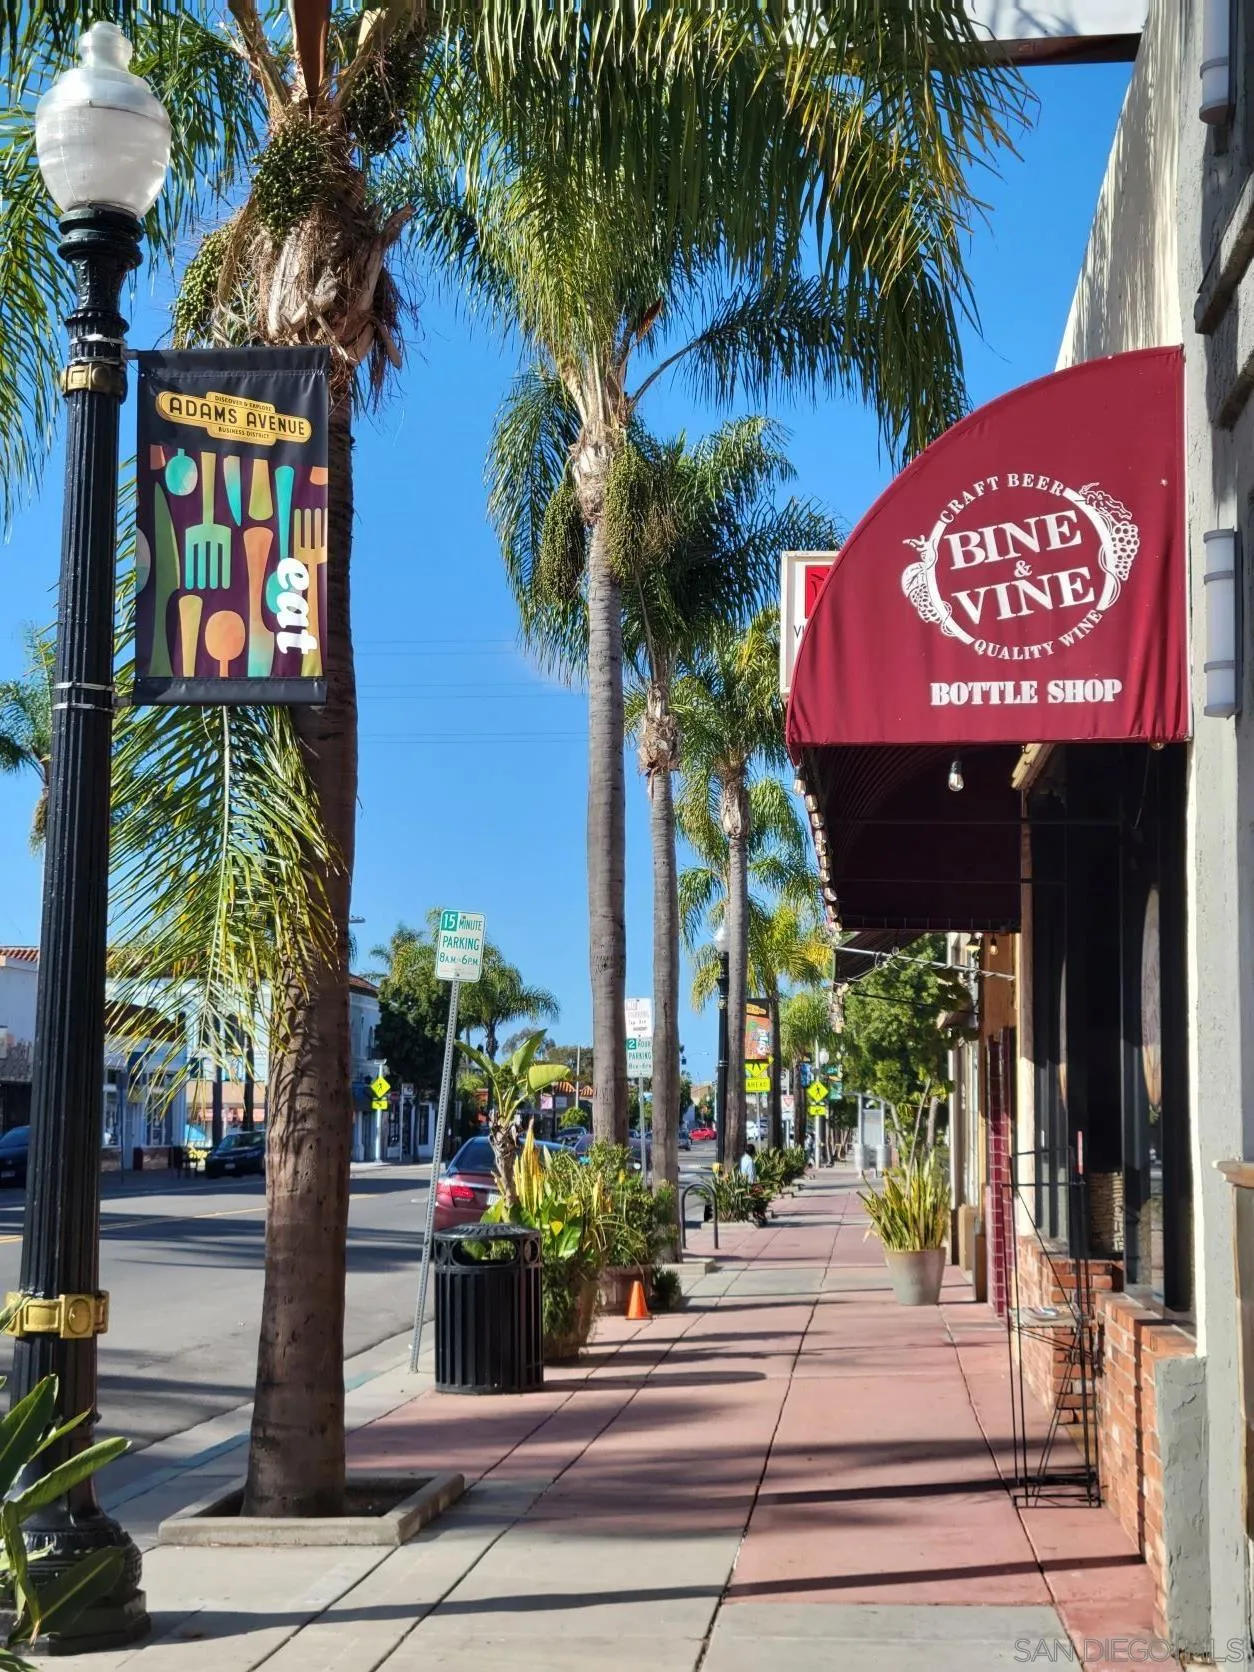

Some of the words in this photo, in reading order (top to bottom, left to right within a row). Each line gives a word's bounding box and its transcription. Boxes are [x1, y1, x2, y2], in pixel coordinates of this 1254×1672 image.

[169, 397, 238, 424] ADAMS
[246, 411, 305, 435] AVENUE
[940, 476, 999, 524] CRAFT
[1007, 473, 1064, 497] BEER
[944, 510, 1083, 570] BINE
[1014, 560, 1032, 577] &
[276, 557, 317, 655] eat
[951, 566, 1095, 625] VINE
[974, 639, 1055, 660] QUALITY
[1058, 609, 1103, 647] WINE
[930, 681, 1038, 706] BOTTLE
[1047, 678, 1123, 704] SHOP
[443, 913, 455, 929] 15
[442, 935, 479, 950] PARKING
[628, 1038, 636, 1049] 2
